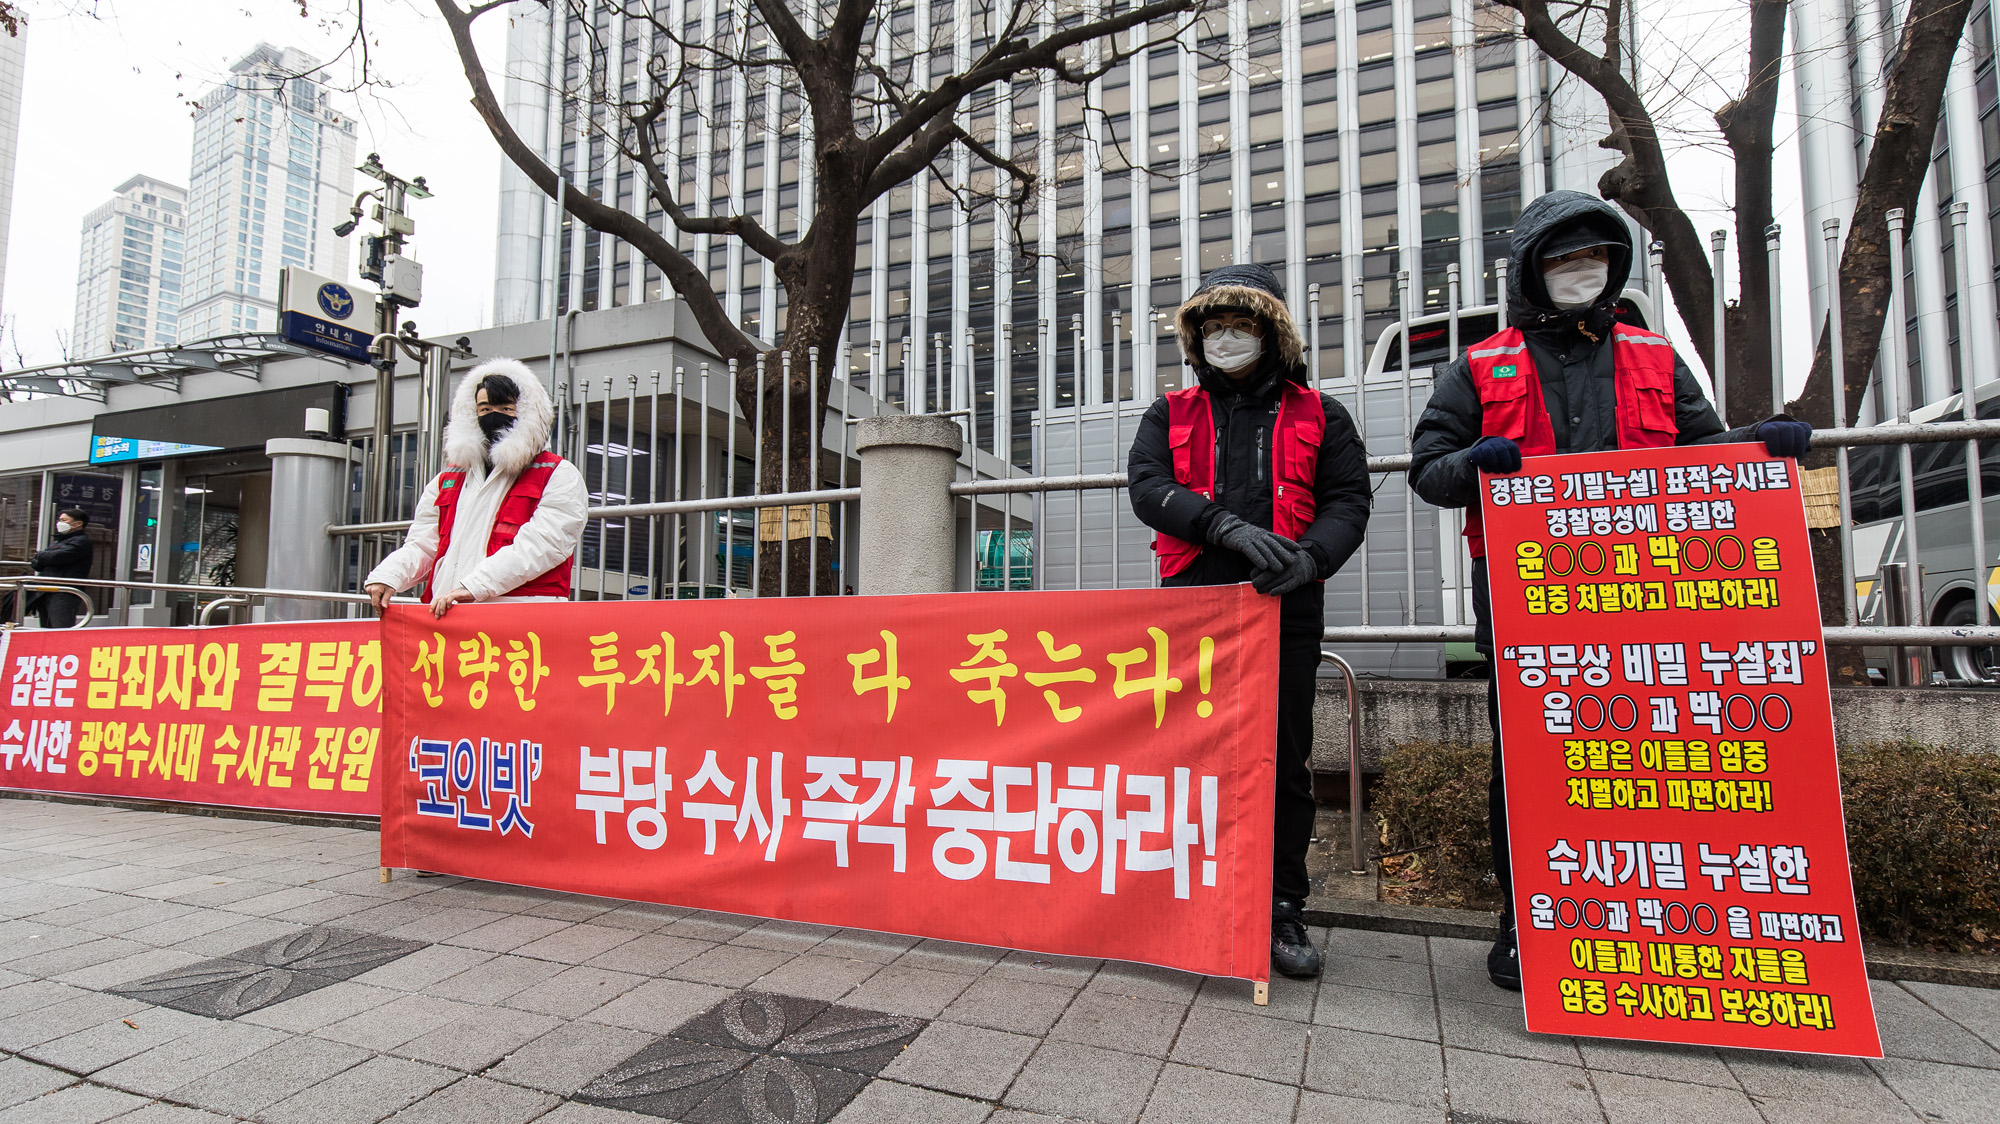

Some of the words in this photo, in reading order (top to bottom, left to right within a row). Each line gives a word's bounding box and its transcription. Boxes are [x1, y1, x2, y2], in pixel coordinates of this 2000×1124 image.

[315, 323, 353, 342] 안내실
[316, 336, 350, 351] Information
[1490, 475, 1554, 506] 경찰은
[1561, 469, 1658, 501] 기밀누설!
[1665, 461, 1790, 494] 표적수사!로
[1546, 504, 1658, 538] 경찰명성에
[1665, 500, 1735, 532] 똥칠한
[1525, 585, 1569, 614] 엄중
[1576, 582, 1667, 612] 처벌하고
[1673, 578, 1778, 610] 파면하라!
[11, 655, 79, 707] 검찰은
[87, 643, 240, 711] 범죄자와
[411, 632, 550, 711] 선량한
[578, 631, 805, 720] 투자자들
[847, 630, 911, 723] 다
[949, 627, 1214, 729] 죽는다!
[1622, 643, 1688, 685] 비밀
[0, 719, 72, 773] 수사한
[78, 721, 205, 782] 광역수사대
[212, 725, 302, 788] 수사관
[308, 727, 380, 792] 전원
[1564, 740, 1632, 771] 경찰은
[1640, 740, 1711, 772] 이들을
[1718, 740, 1767, 773] 엄중
[1567, 778, 1659, 809] 처벌하고
[1666, 779, 1772, 812] 파면하라!
[576, 746, 672, 849] 부당
[683, 750, 791, 861] 수사
[802, 756, 916, 873] 즉각
[927, 759, 1217, 899] 중단하라!
[1547, 839, 1686, 889] 수사기밀
[1699, 843, 1809, 894] 누설한
[1759, 912, 1843, 942] 파면하고
[1571, 938, 1642, 974] 이들과
[1648, 942, 1723, 979] 내통한
[1729, 947, 1808, 984] 자들을
[1559, 978, 1607, 1015] 엄중
[1615, 982, 1714, 1020] 수사하고
[1720, 989, 1834, 1029] 보상하라!
